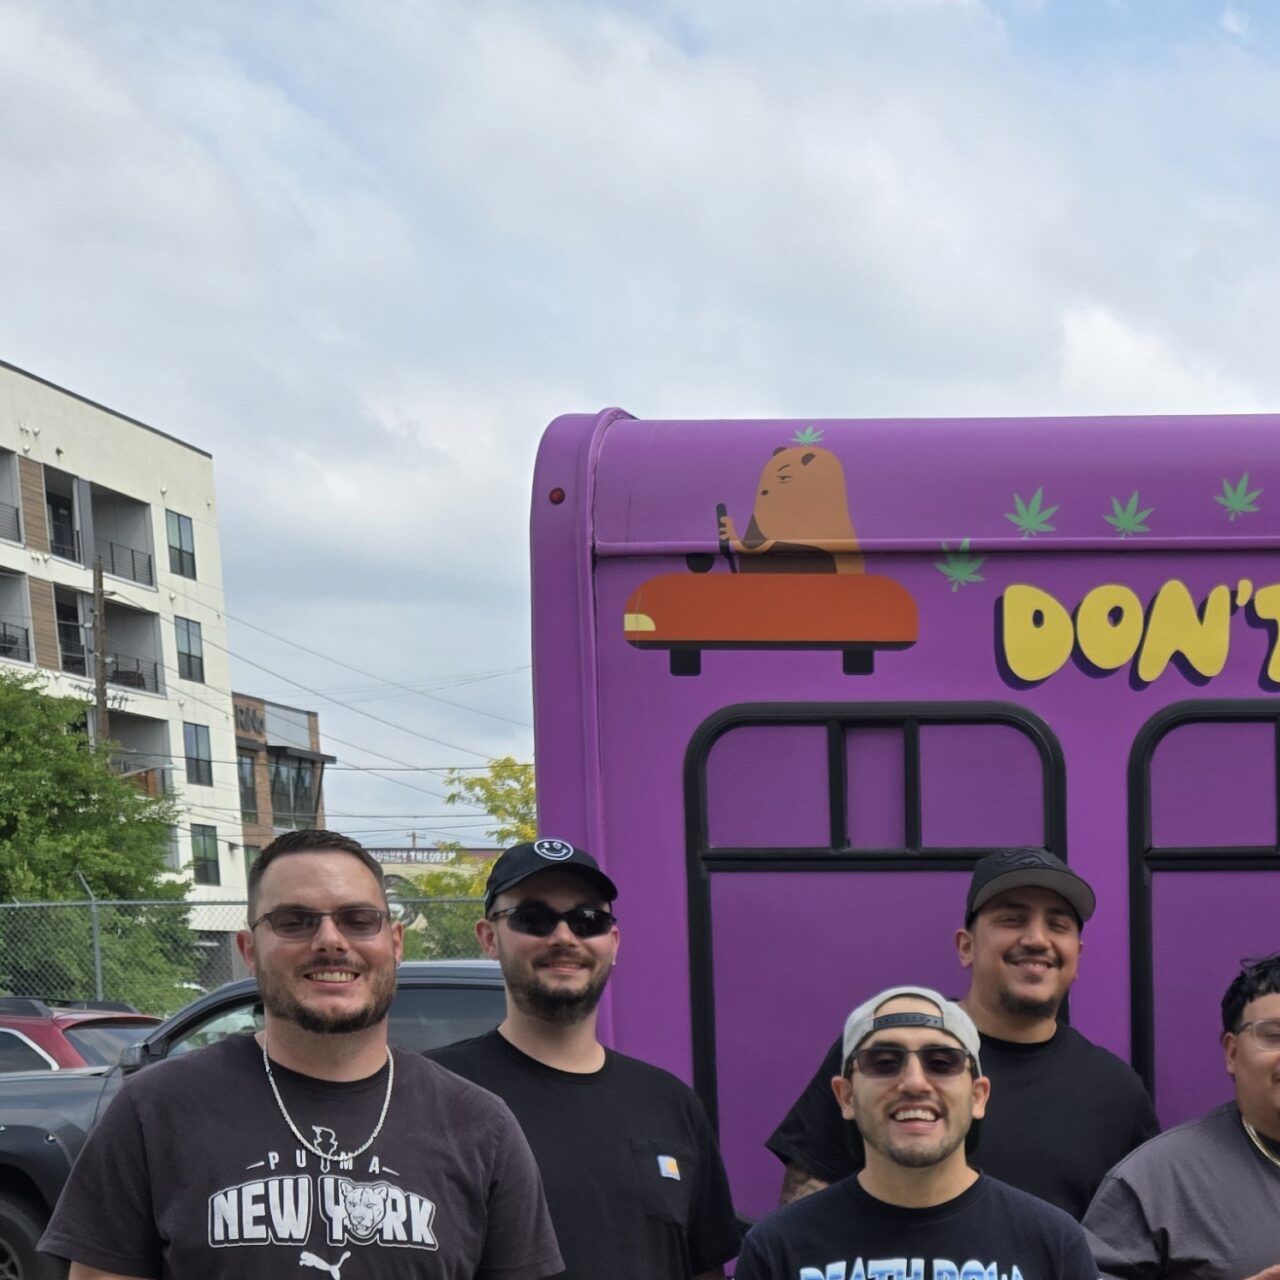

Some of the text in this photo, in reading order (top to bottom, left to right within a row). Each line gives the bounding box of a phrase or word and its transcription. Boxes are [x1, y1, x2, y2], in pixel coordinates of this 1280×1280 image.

[267, 1150, 381, 1174] PUMA
[209, 1175, 439, 1250] NEW YRK
